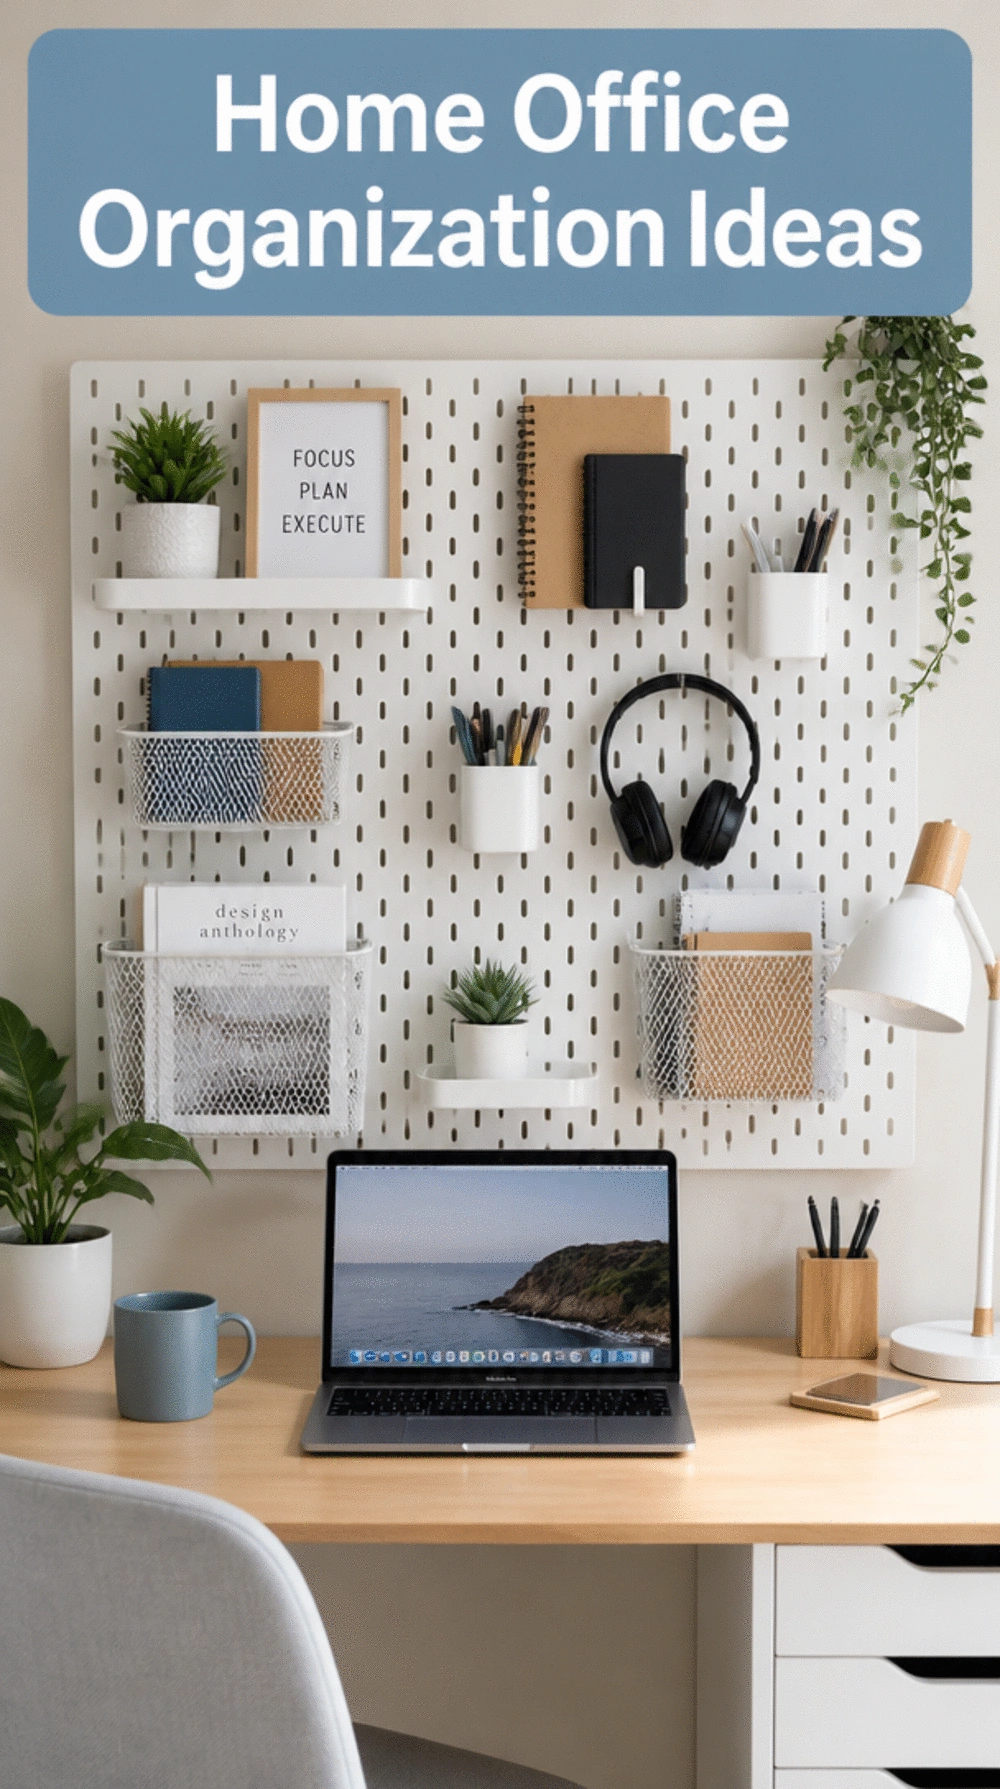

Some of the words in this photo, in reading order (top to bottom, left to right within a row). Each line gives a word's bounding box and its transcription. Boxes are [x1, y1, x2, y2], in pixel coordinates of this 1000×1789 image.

[293, 449, 355, 467] FOCUS
[300, 482, 348, 499] PLAN
[282, 514, 366, 533] EXECUTE
[215, 904, 284, 921] design
[200, 923, 299, 942] anthology
